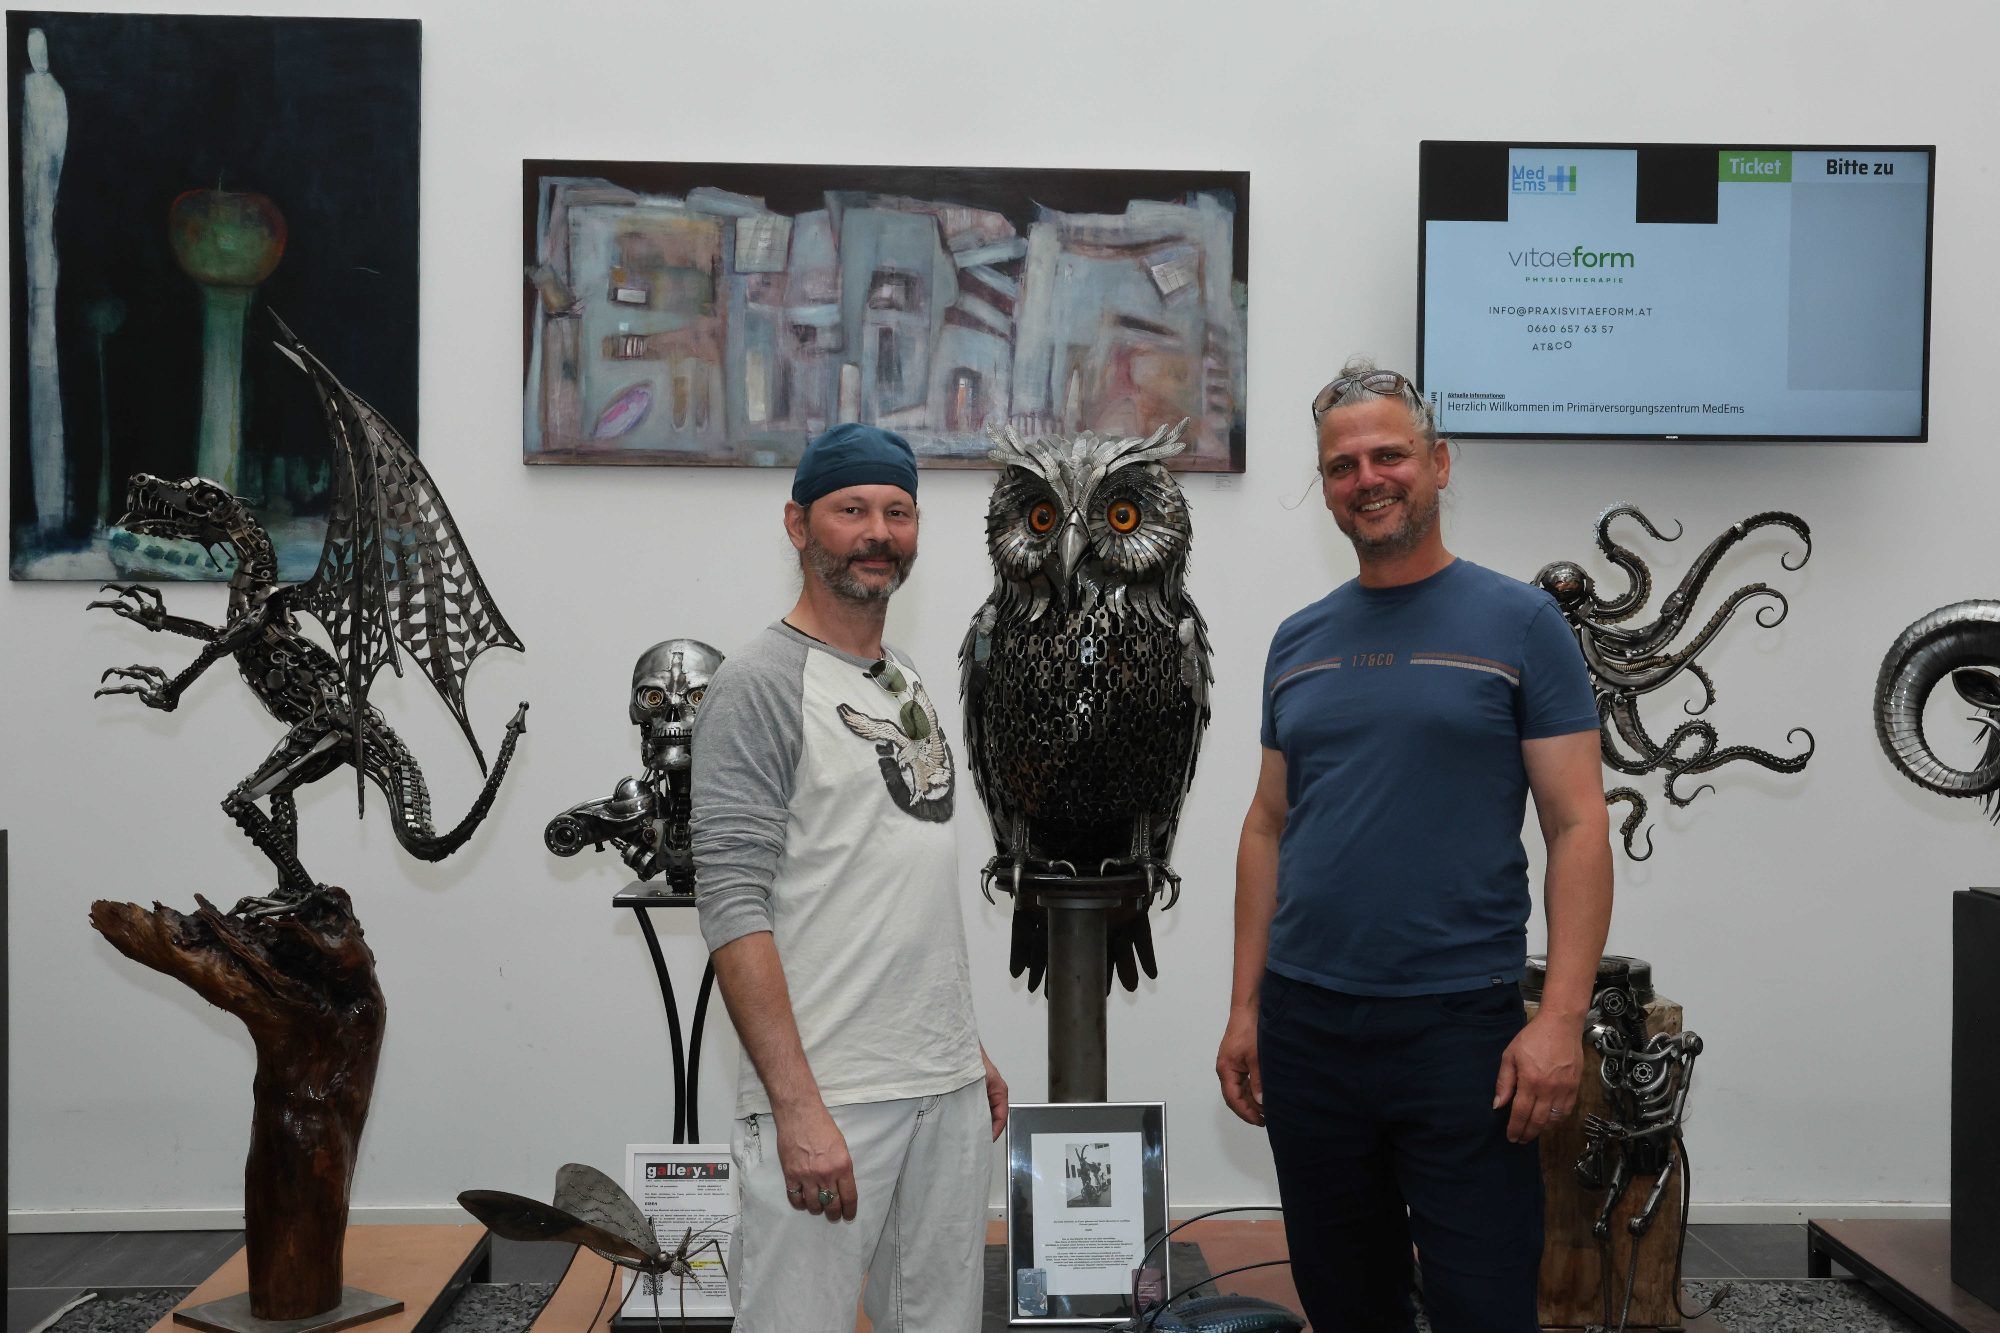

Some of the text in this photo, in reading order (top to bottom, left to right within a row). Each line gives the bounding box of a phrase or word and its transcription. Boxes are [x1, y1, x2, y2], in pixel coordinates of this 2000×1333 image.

[1512, 165, 1545, 180] Med
[1729, 157, 1782, 175] Ticket
[1826, 158, 1894, 175] Bitte zu
[1512, 180, 1546, 192] Ems
[1508, 245, 1635, 268] vitaeform
[1525, 276, 1625, 284] PHYSIOTHERAPIE
[1488, 306, 1653, 317] INFO@PRAXISVITAEFORM.AT
[1527, 324, 1614, 334] 0660 657 63 57
[1532, 340, 1572, 351] AT&CO
[1447, 401, 1745, 416] Herzlich Willkommen im Primärversorgungszentrum MedEms
